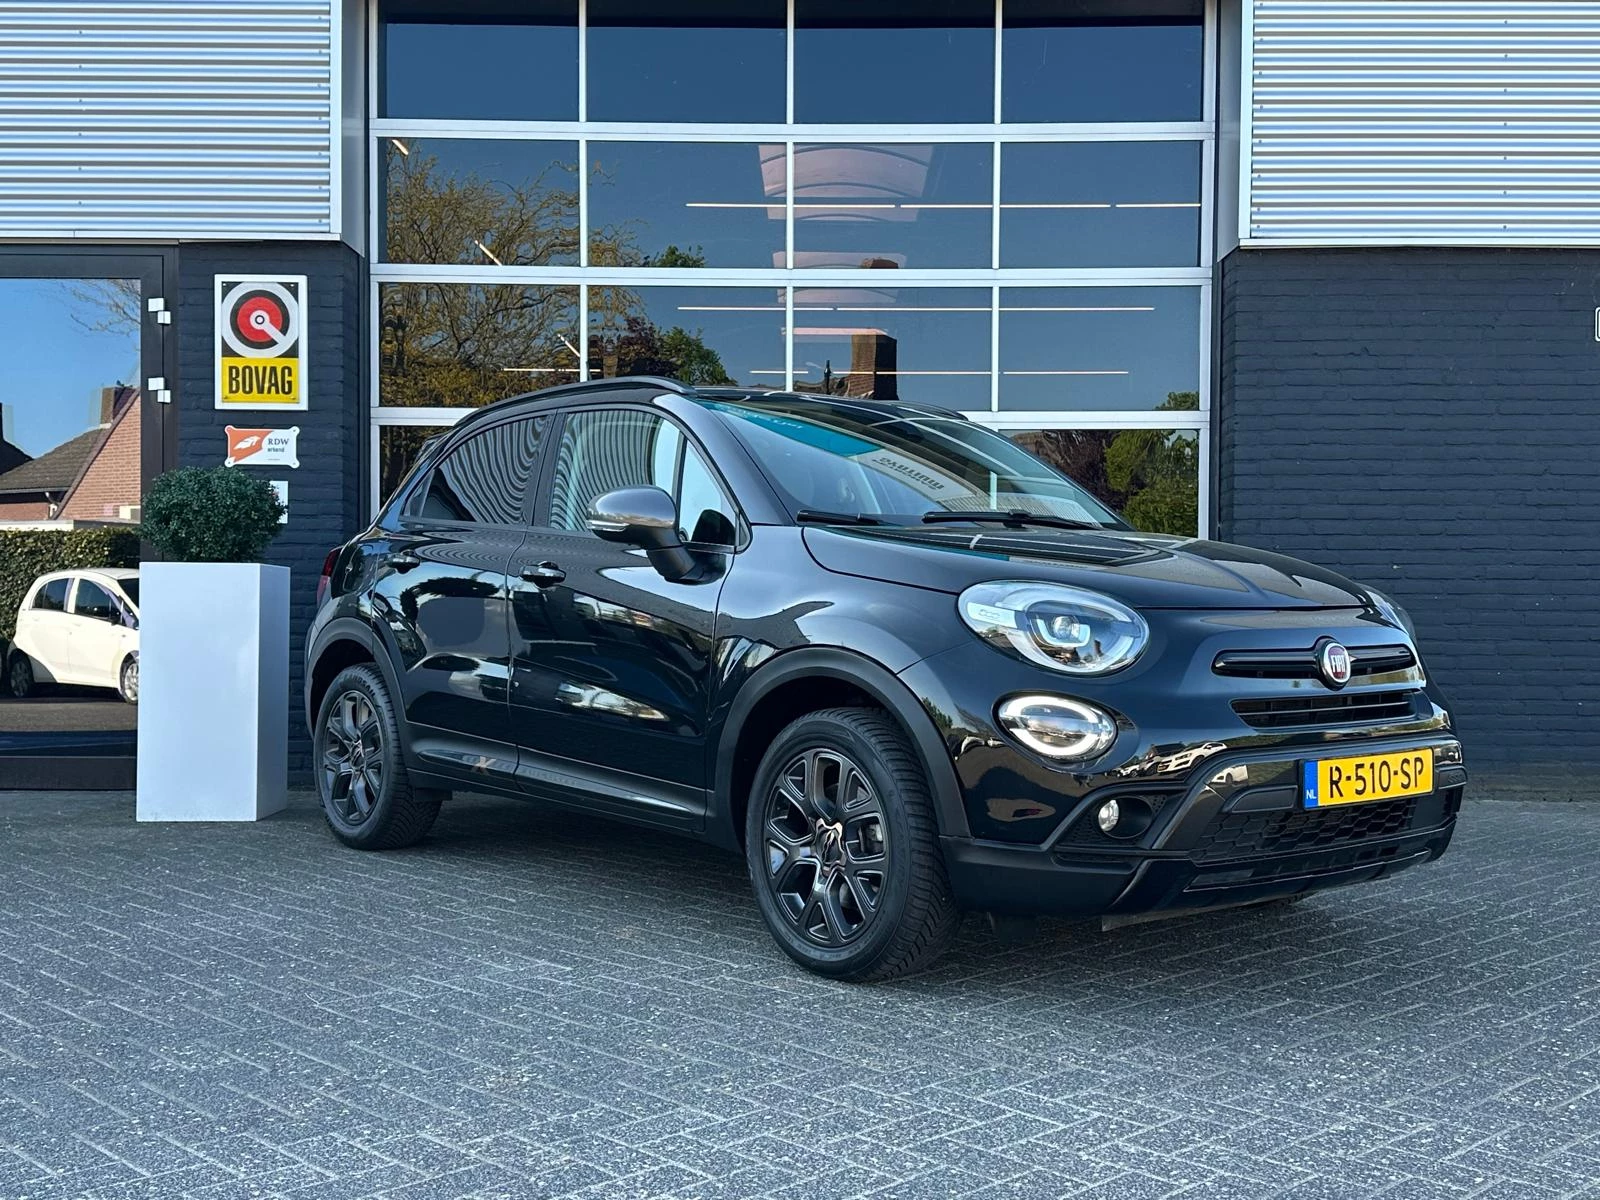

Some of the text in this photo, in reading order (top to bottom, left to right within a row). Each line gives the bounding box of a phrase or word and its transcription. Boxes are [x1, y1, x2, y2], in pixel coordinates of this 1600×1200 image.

[228, 365, 293, 394] BOVAG
[1330, 654, 1346, 673] FIAT
[1329, 756, 1425, 799] R-510-SP
[1306, 789, 1317, 800] NL
